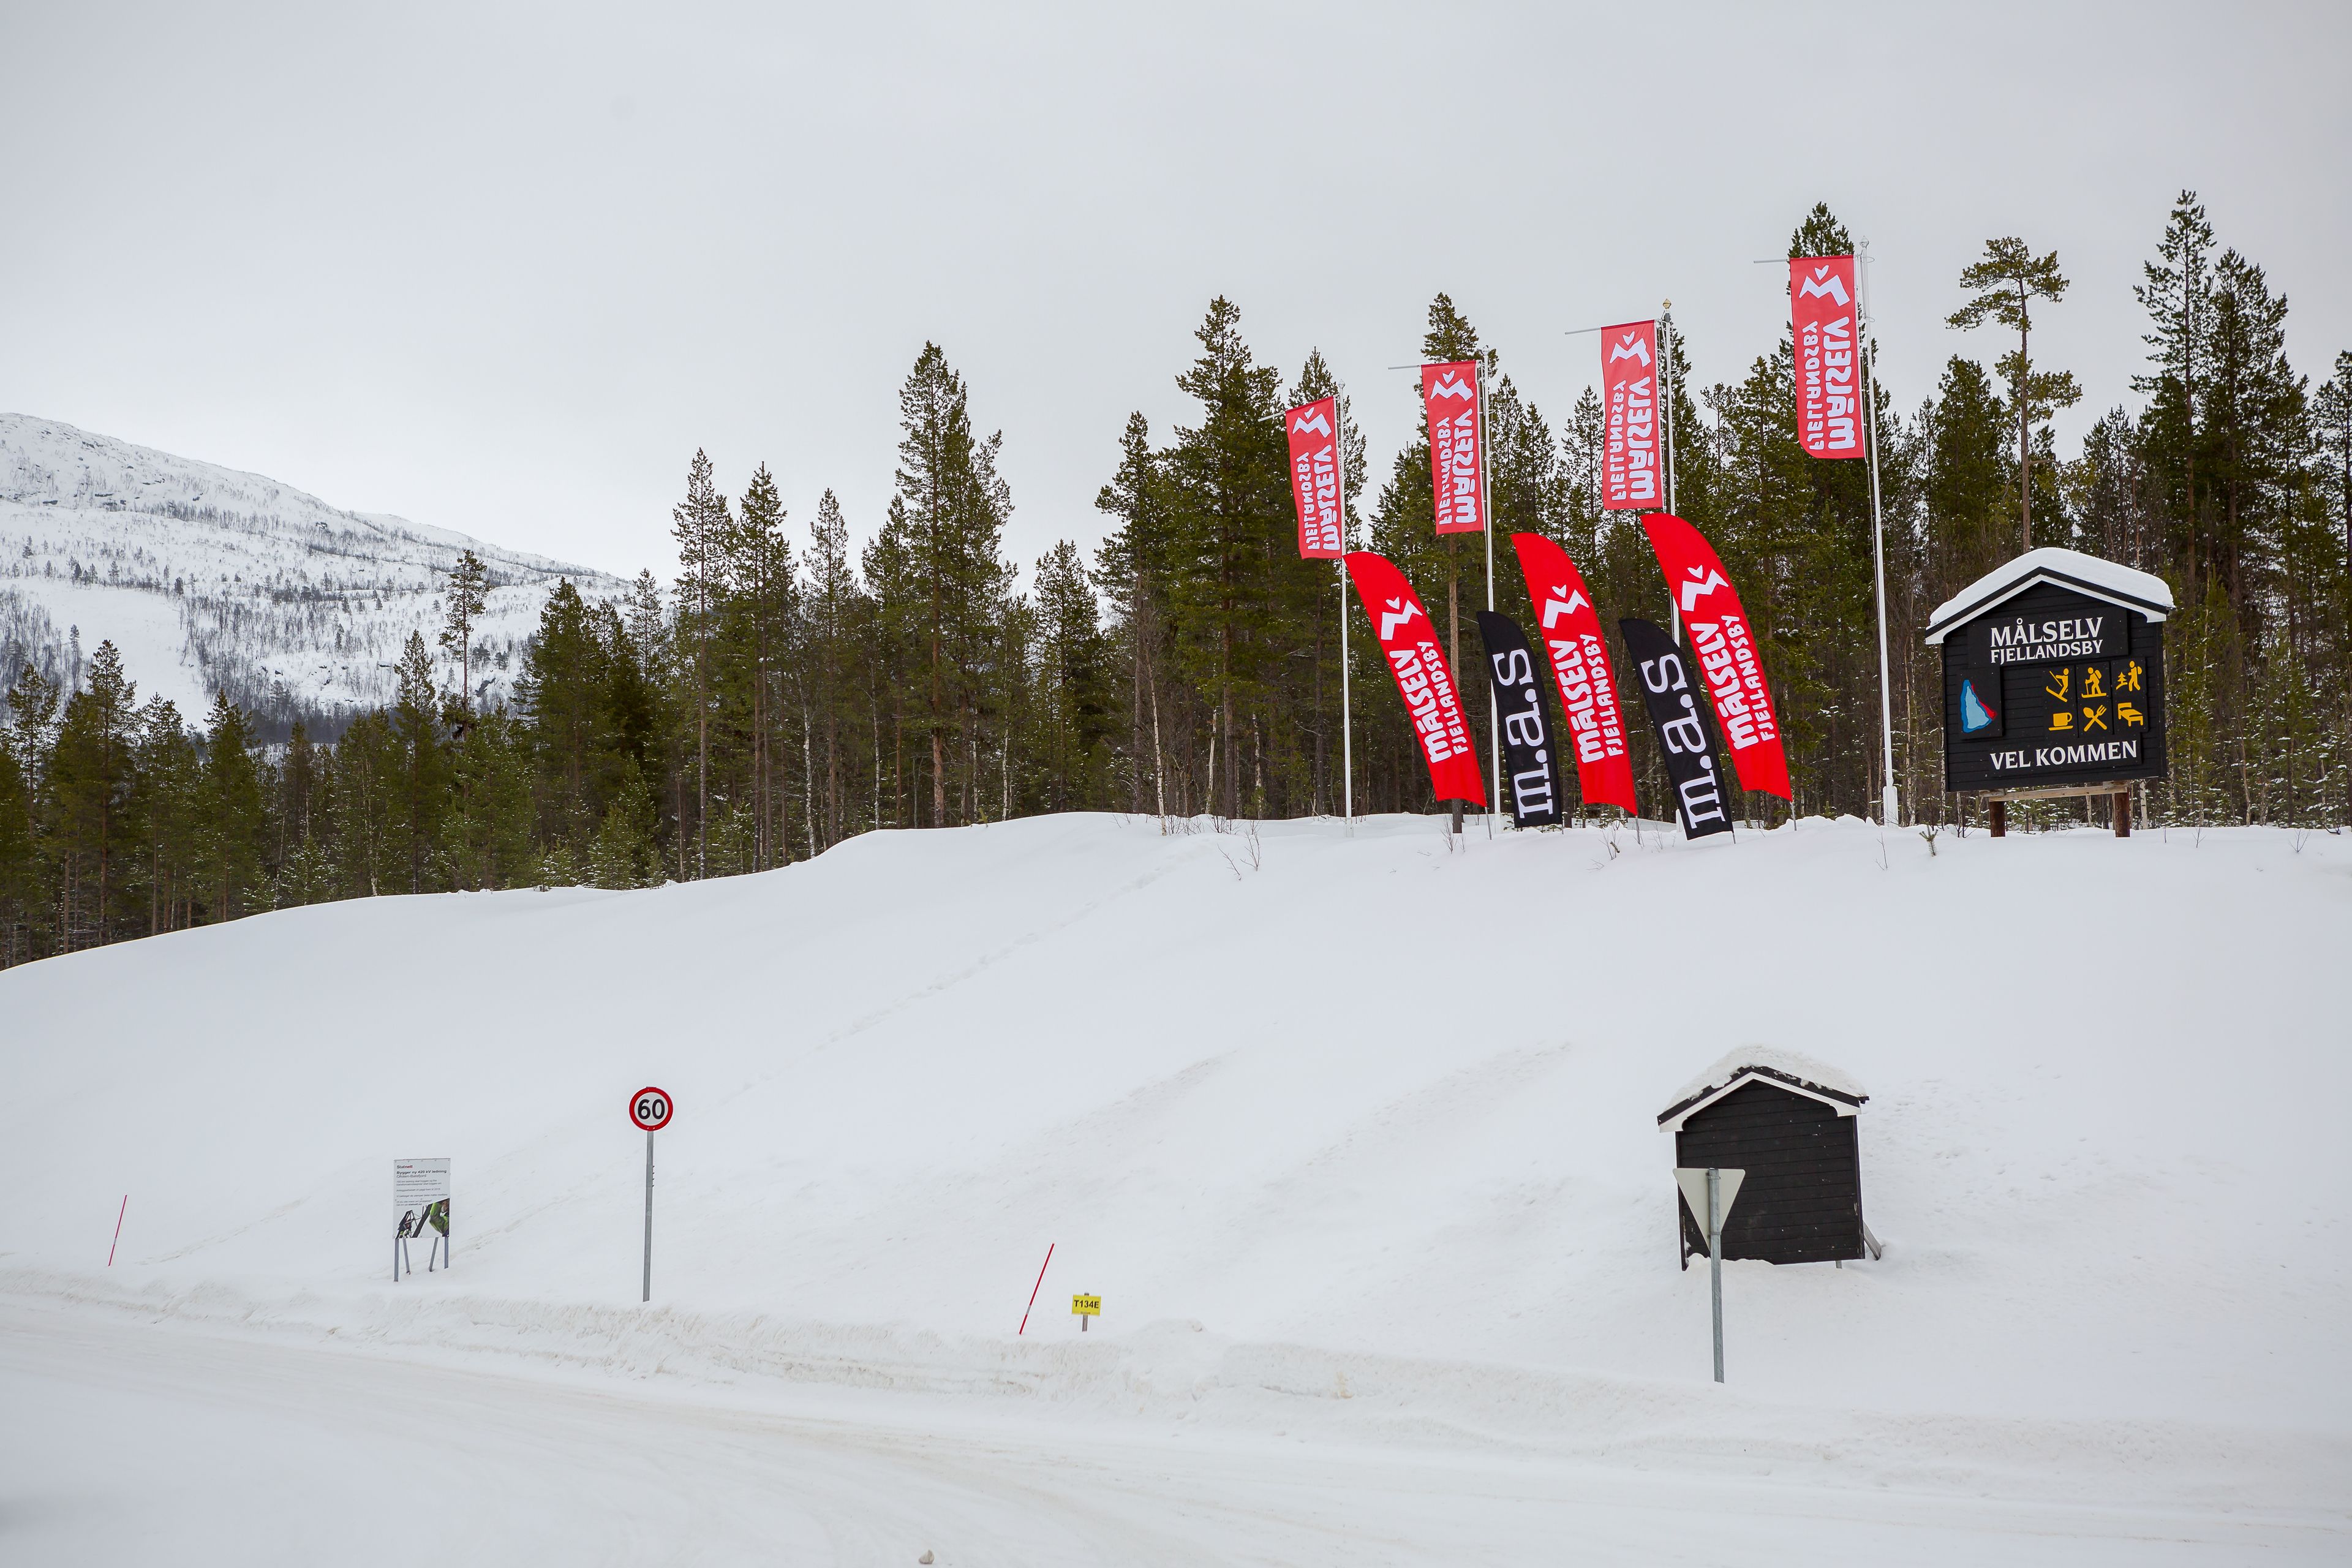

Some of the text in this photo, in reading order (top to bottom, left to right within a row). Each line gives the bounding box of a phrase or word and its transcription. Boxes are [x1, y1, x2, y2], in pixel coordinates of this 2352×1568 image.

[1989, 616, 2104, 648] MÅLSELV
[1989, 638, 2103, 665] FJELLANDSBY
[1416, 641, 1469, 755] FJELLANDSBY
[1579, 633, 1624, 756] FJELLANDSBY
[1721, 614, 1776, 742] FJELLANDSBY
[1492, 648, 1553, 820] m.a.s
[1640, 652, 1726, 829] m.a.s
[1989, 739, 2138, 771] VEL KOMMEN
[637, 1098, 666, 1120] 60
[1074, 1299, 1099, 1309] T134E
